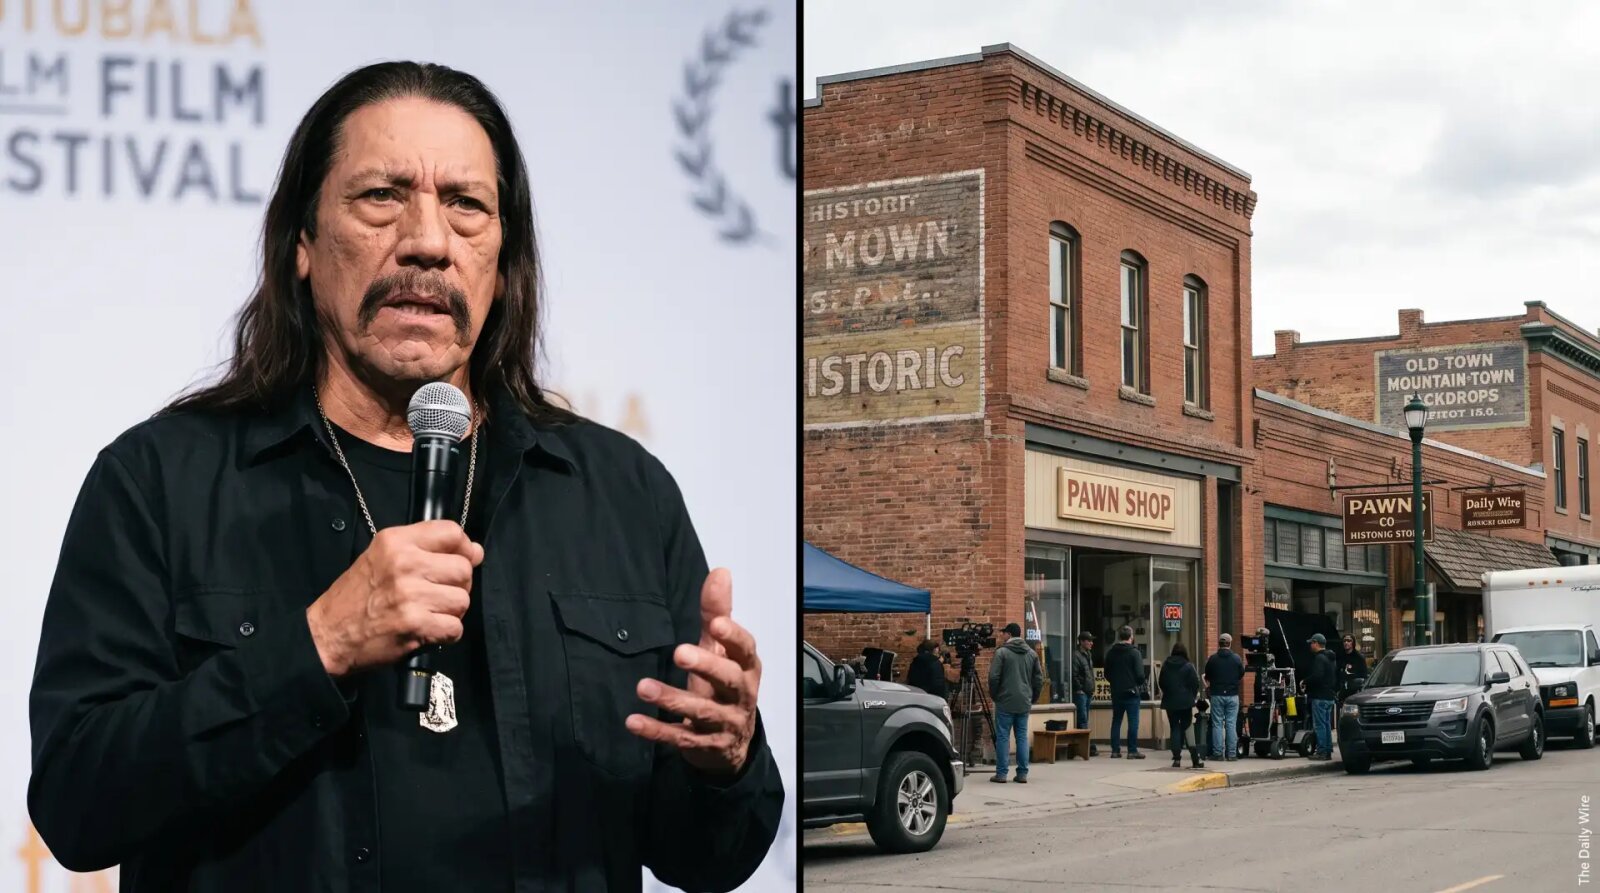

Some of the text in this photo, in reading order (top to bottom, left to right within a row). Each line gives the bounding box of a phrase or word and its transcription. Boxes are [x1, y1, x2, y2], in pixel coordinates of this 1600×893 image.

[100, 56, 264, 124] FILM
[0, 130, 263, 204] STIVAL
[807, 345, 965, 398] ISTORIC
[1405, 353, 1493, 372] OLD TOWN
[1067, 478, 1171, 520] PAWN SHOP
[1466, 496, 1521, 511] Daily Wire
[1379, 517, 1395, 527] CO
